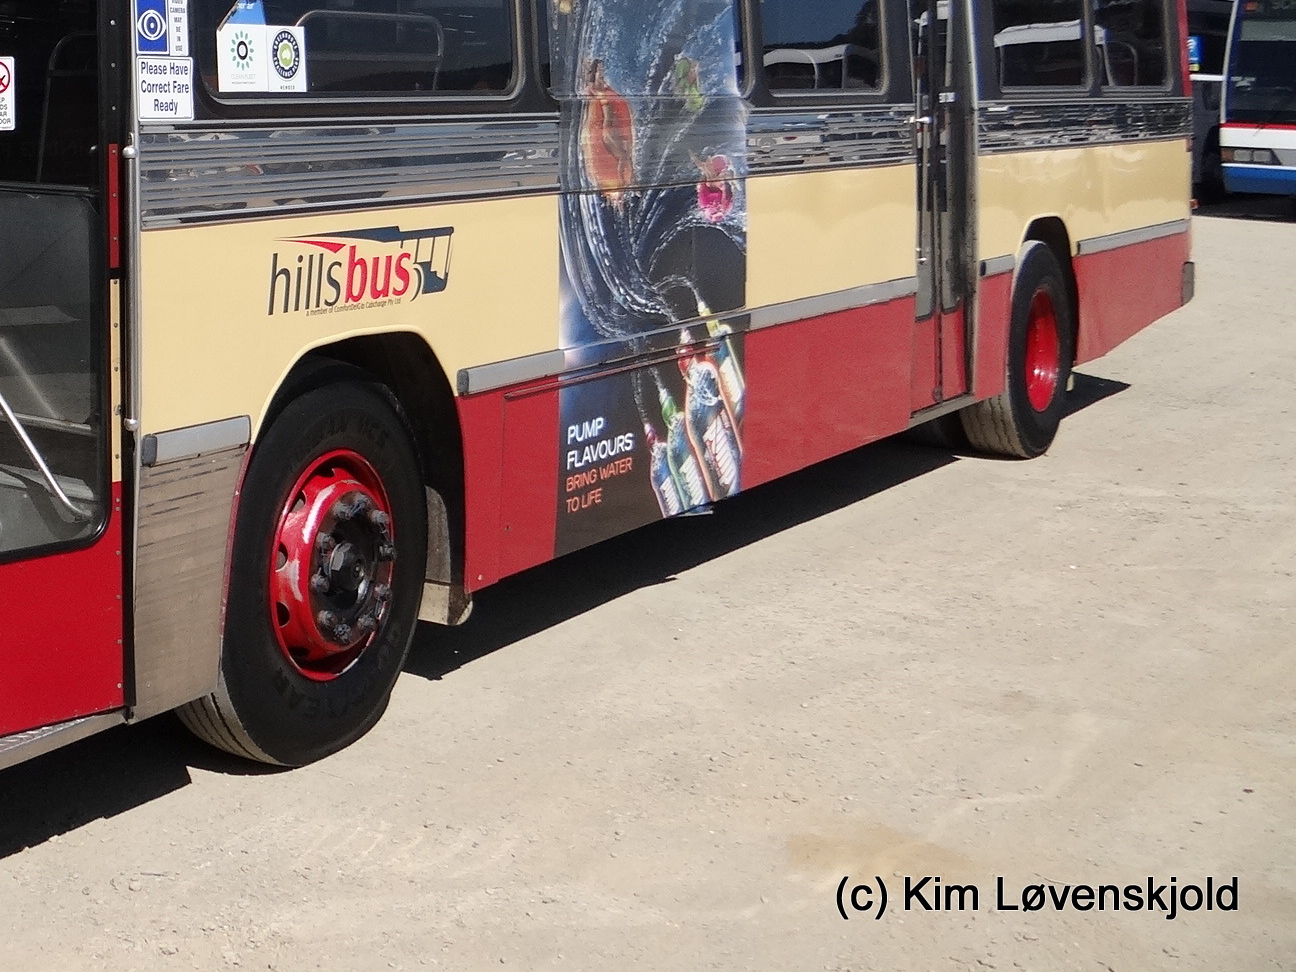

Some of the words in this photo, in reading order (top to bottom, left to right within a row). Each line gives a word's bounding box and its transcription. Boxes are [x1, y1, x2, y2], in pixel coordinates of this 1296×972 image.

[140, 61, 168, 75] Please
[169, 62, 189, 75] Have
[140, 79, 171, 94] Correct
[172, 80, 190, 94] Fare
[153, 98, 178, 116] Ready
[267, 245, 412, 316] hillsbus
[309, 308, 328, 316] member
[567, 416, 604, 445] PUMP
[566, 432, 634, 471] FLAVOURS
[566, 468, 598, 492] BRING
[599, 457, 633, 480] WATER
[566, 496, 580, 514] TO
[581, 488, 603, 509] LIFE
